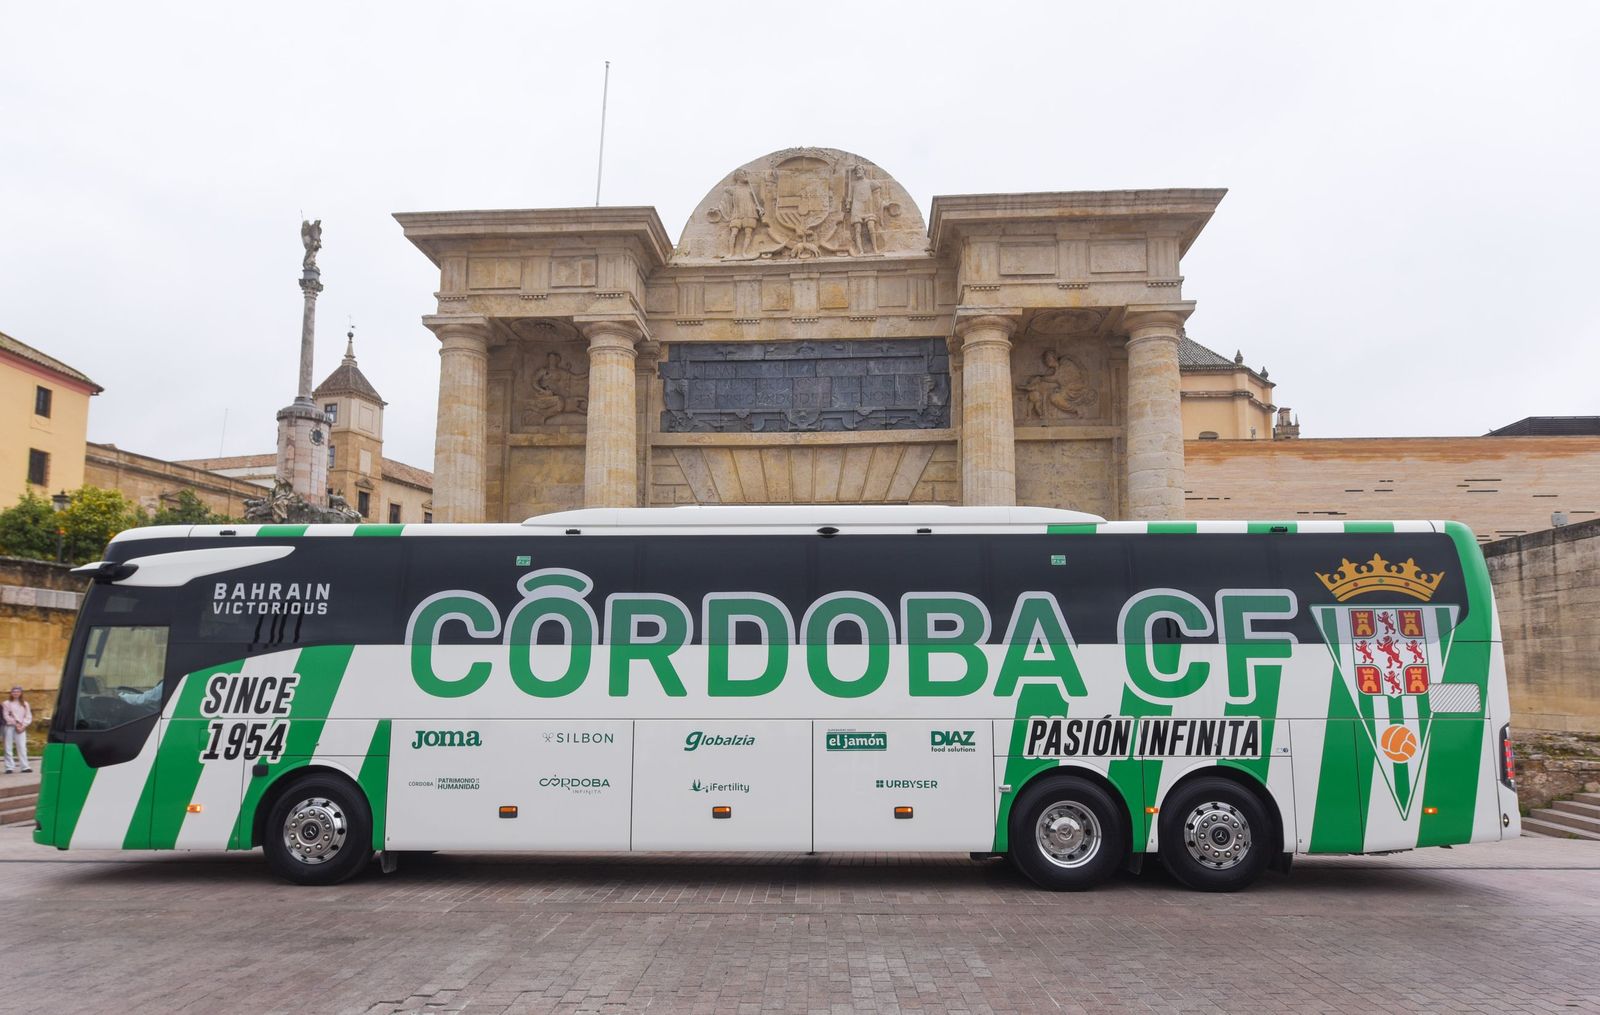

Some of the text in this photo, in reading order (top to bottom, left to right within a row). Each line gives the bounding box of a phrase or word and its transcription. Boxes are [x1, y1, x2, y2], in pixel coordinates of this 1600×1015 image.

[213, 583, 331, 600] BAHRAIN
[213, 602, 328, 615] VICTORIOUS
[1118, 588, 1298, 700] CF
[203, 676, 297, 714] SINCE
[202, 722, 287, 760] 1954
[556, 732, 614, 744] SILBON
[683, 731, 756, 752] globalzia
[828, 733, 885, 749] el jamón
[930, 730, 976, 746] DIAZ
[1027, 715, 1259, 756] PASIÓN INFINITA
[709, 782, 750, 794] iFertility
[885, 779, 938, 789] URBYSER
